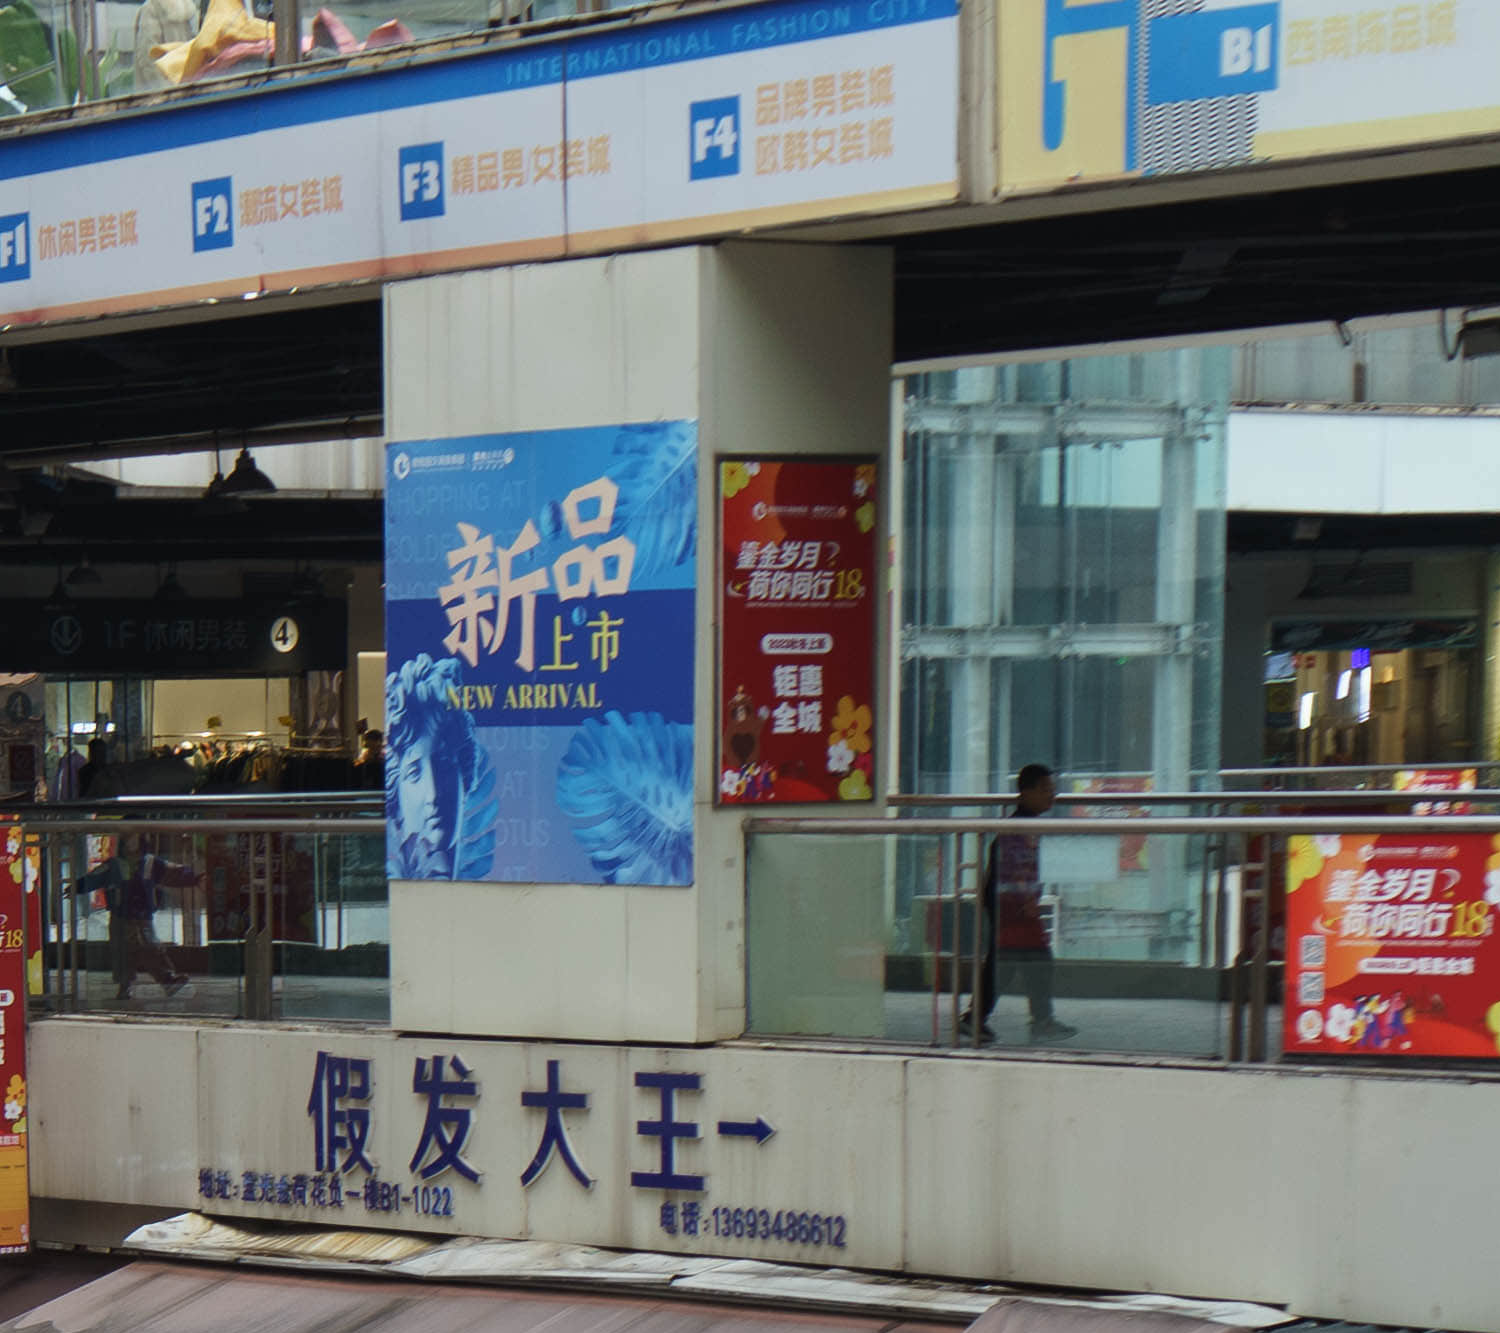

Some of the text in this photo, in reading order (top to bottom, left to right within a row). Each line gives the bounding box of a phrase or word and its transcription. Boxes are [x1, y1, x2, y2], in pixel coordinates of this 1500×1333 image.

[506, 29, 715, 86] INTERNATIONAL
[731, 3, 852, 53] FASHION
[1219, 23, 1270, 77] B1
[694, 63, 896, 164] F4 品牌男装城
[197, 174, 345, 234] F2 潮流女装城
[402, 158, 440, 203] F3
[0, 209, 139, 268] F1 休闲男装城
[438, 475, 636, 673] 新品
[539, 610, 625, 673] 上市
[446, 682, 603, 711] NEW ARRIVAL
[772, 664, 824, 697] 钜惠
[771, 701, 823, 734] 全城
[307, 1049, 706, 1191] 假发大王
